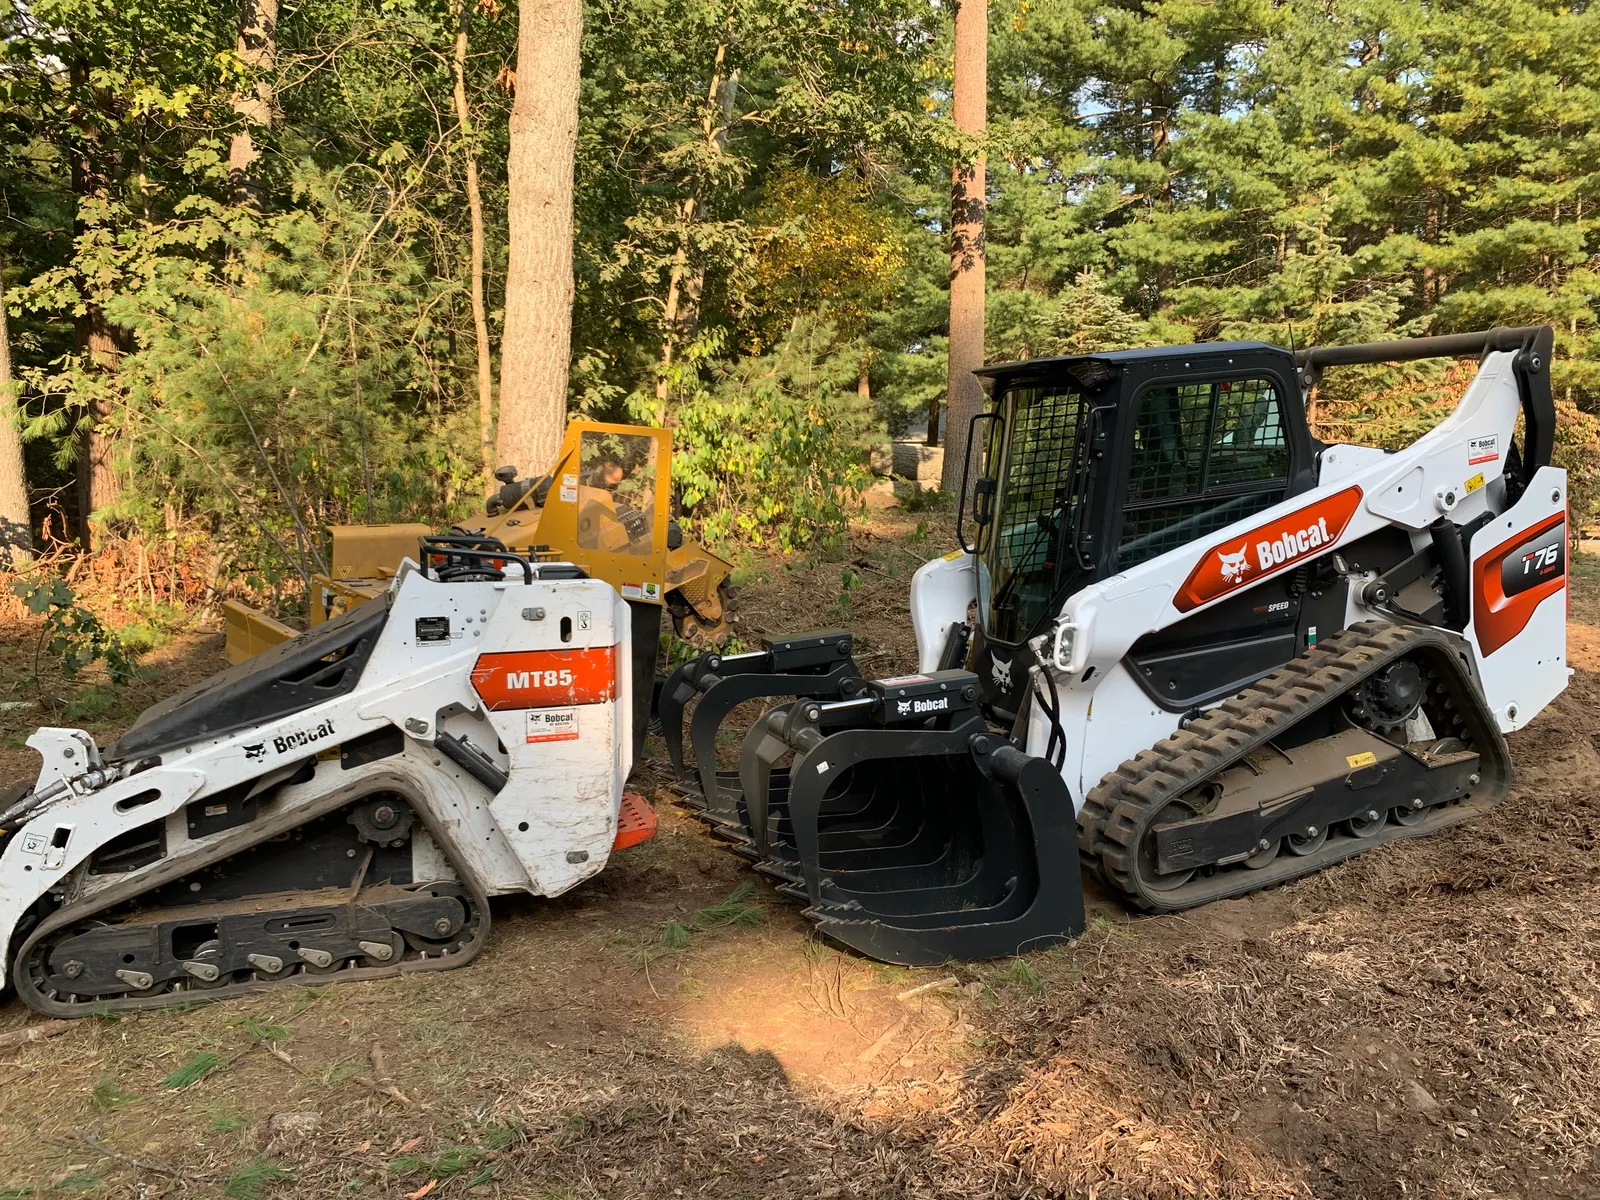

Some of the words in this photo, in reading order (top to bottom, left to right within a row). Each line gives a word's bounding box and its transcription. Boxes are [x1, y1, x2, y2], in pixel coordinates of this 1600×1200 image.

[1478, 438, 1496, 448] Bobcat
[1256, 516, 1330, 571] Bobcat
[1522, 543, 1559, 575] T76
[1268, 601, 1289, 612] SPEED
[507, 669, 573, 690] MT85
[914, 697, 948, 713] Bobcat
[545, 713, 573, 723] Bobcat
[273, 719, 336, 754] Bobcat
